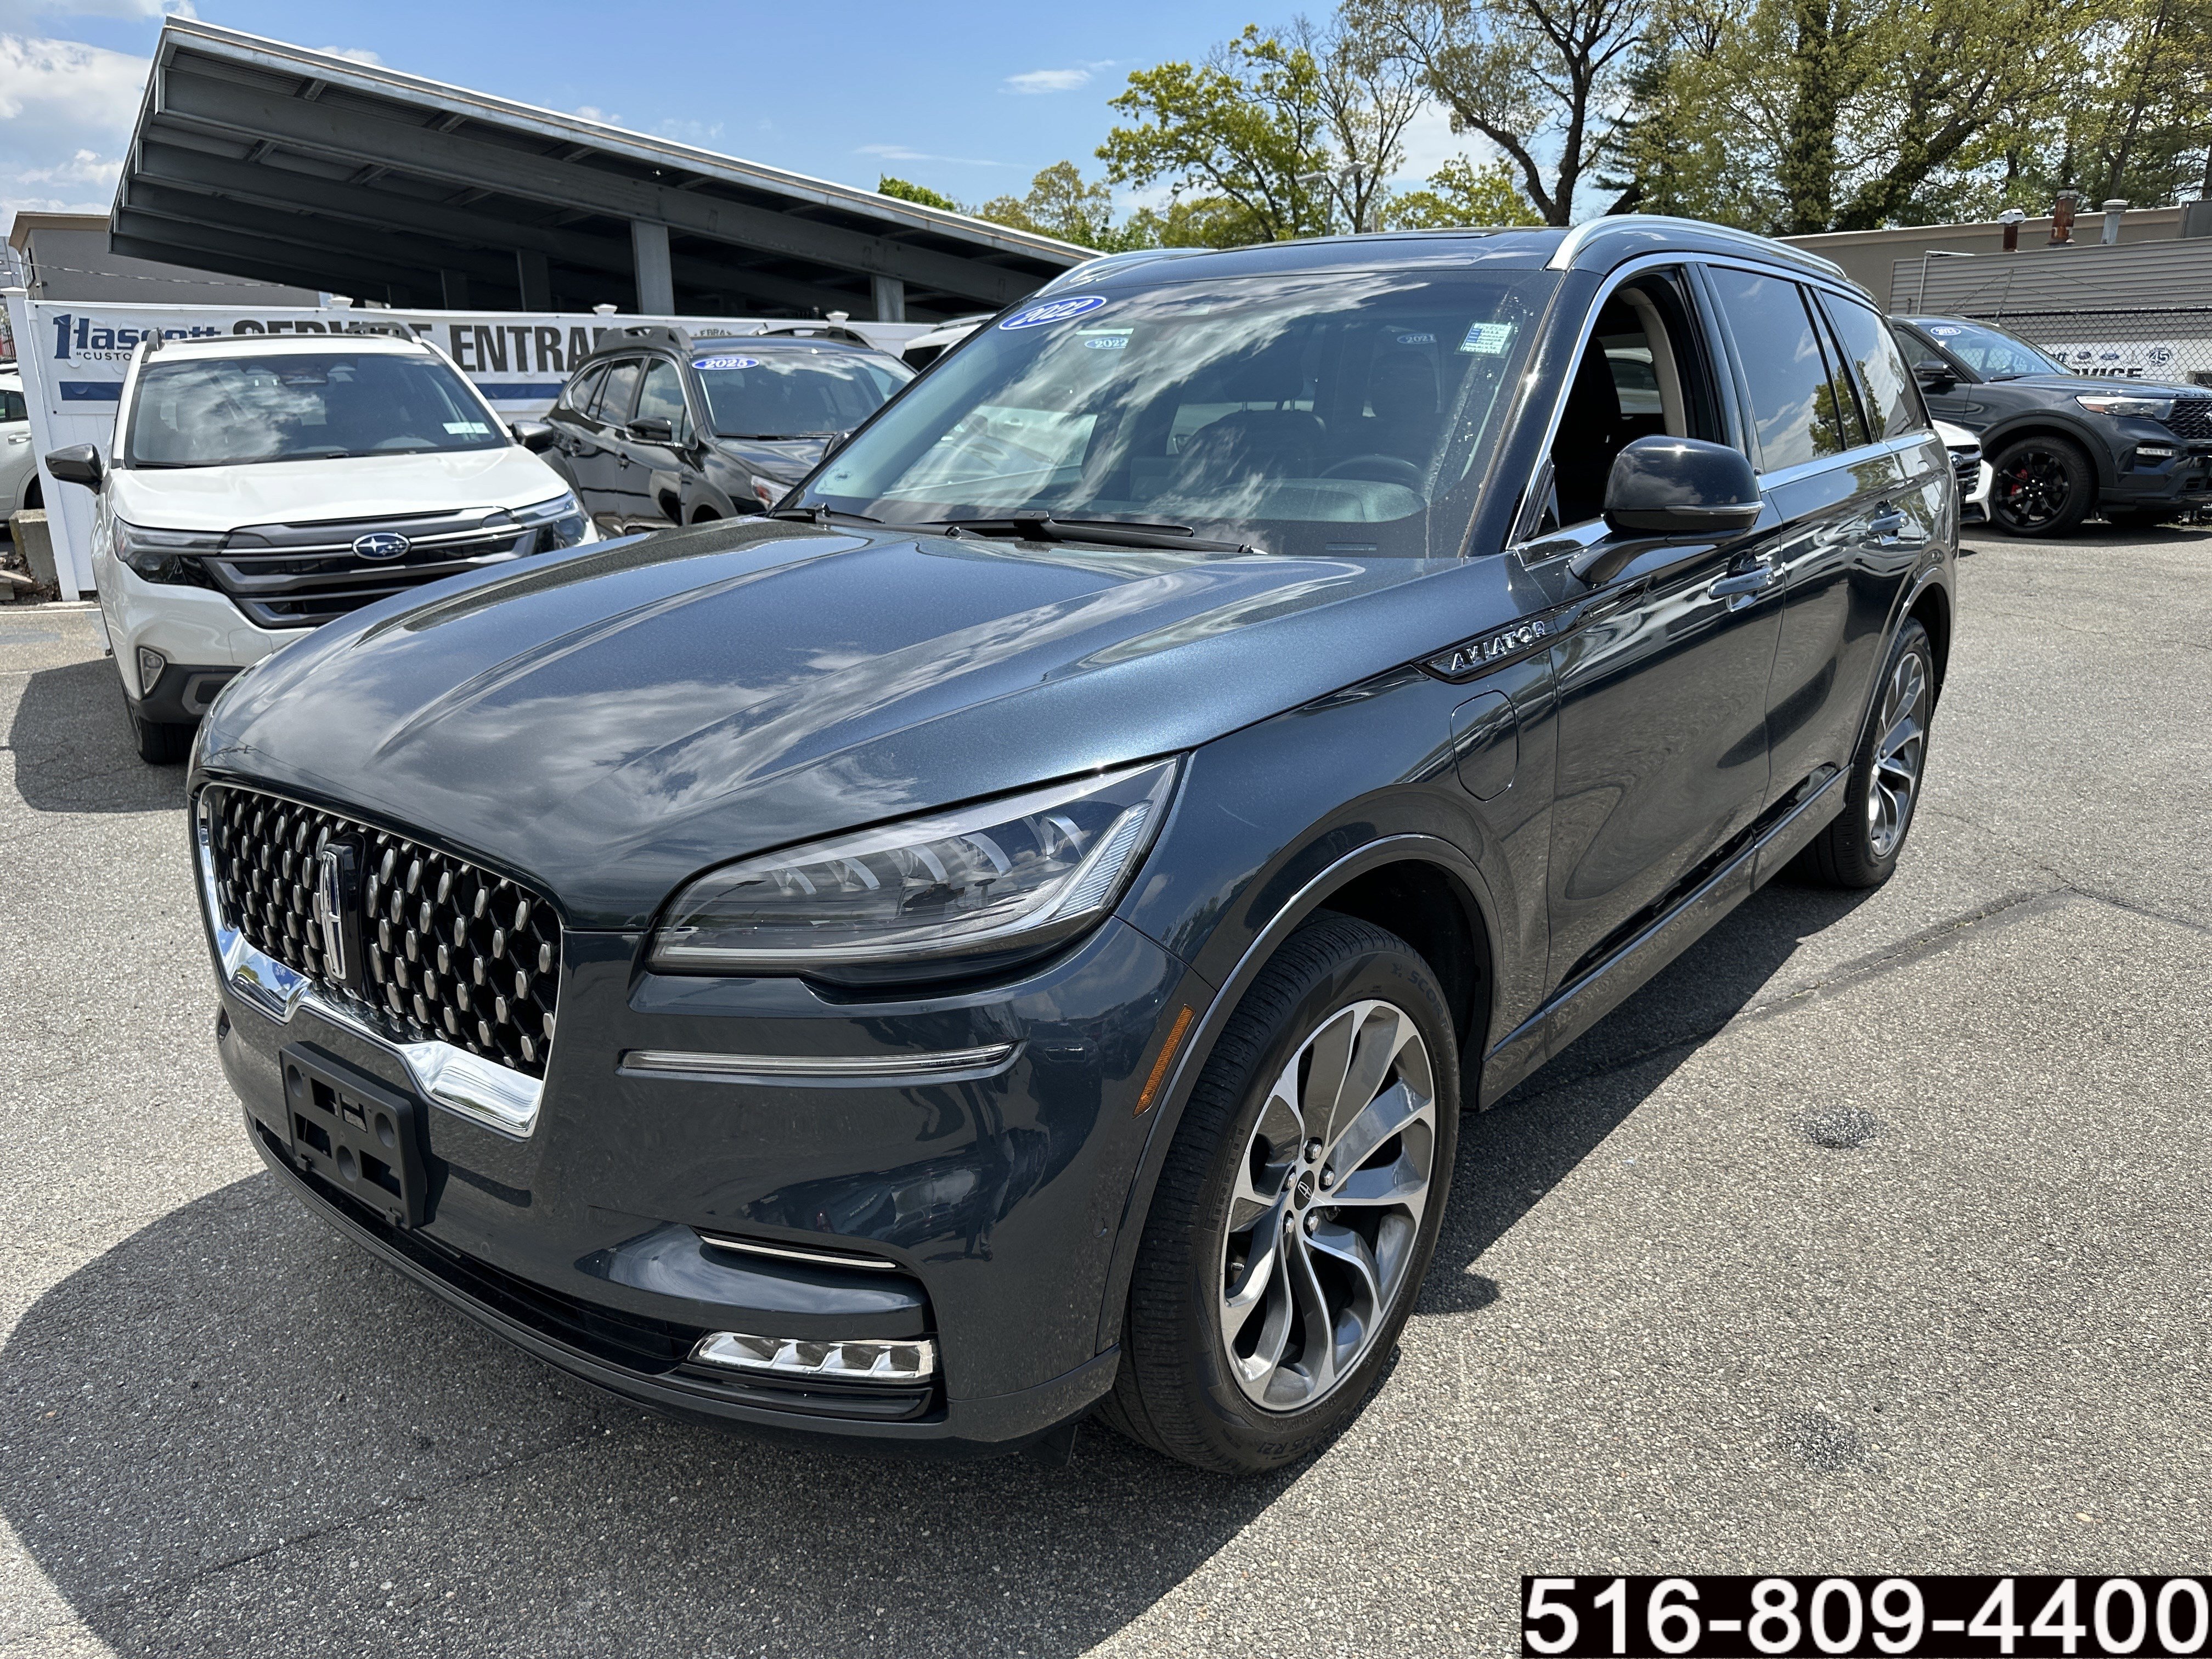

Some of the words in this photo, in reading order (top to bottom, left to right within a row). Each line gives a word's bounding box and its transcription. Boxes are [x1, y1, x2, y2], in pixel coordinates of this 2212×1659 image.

[1008, 299, 1094, 327] 2022
[704, 359, 748, 369] 2025
[1451, 620, 1546, 671] AVIATOR
